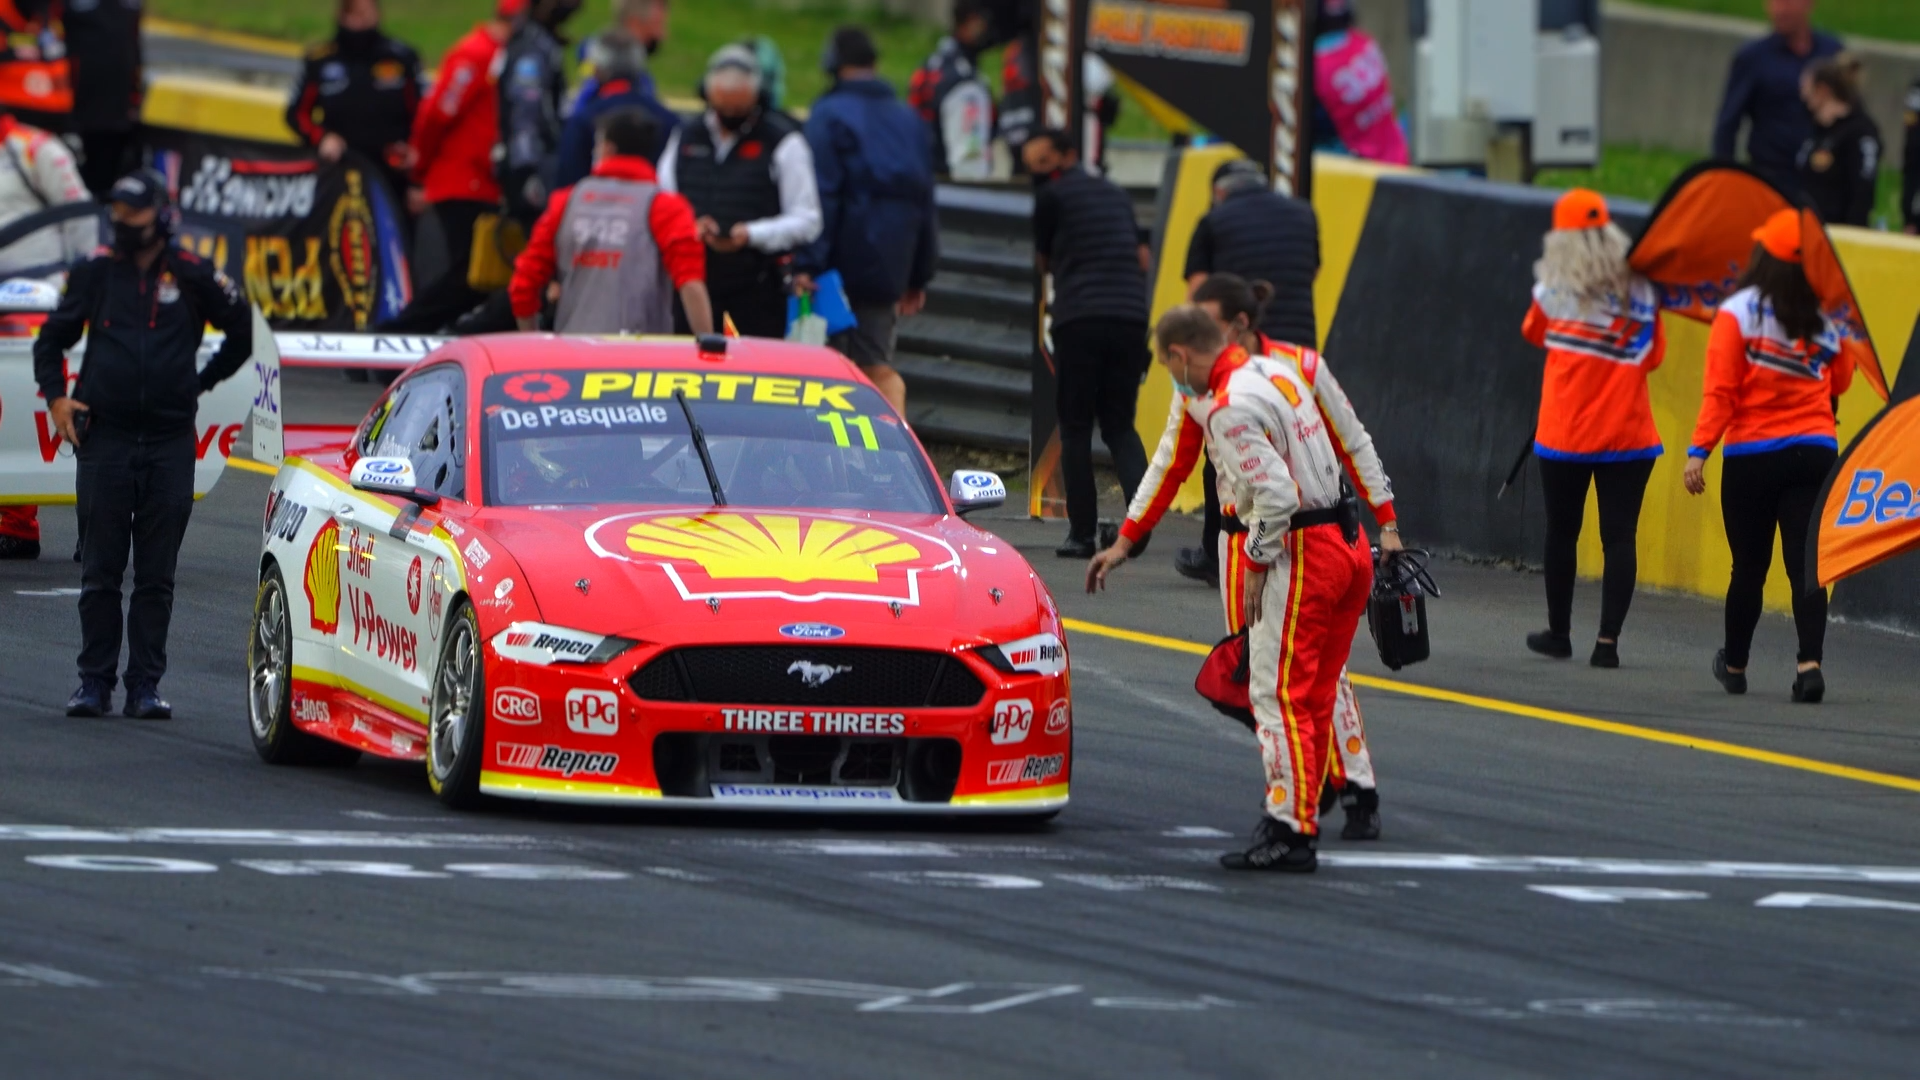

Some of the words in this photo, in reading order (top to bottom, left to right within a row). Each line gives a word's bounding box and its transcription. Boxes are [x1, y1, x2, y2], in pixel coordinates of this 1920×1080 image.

[581, 372, 858, 411] PIRTEK
[502, 408, 537, 431] De
[543, 403, 667, 427] Pasquale
[816, 410, 880, 451] 11
[347, 526, 374, 578] Shell
[347, 583, 417, 673] V-Power
[533, 633, 595, 656] Repco
[1040, 644, 1063, 663] Repco
[303, 698, 331, 723] HOGS
[496, 693, 537, 718] CRC
[1050, 704, 1068, 727] CRC
[721, 708, 805, 732] THREE
[809, 711, 905, 735] THREES
[540, 744, 619, 777] Repco
[1021, 754, 1064, 785] Repco
[718, 784, 892, 800] Beaurepaires
